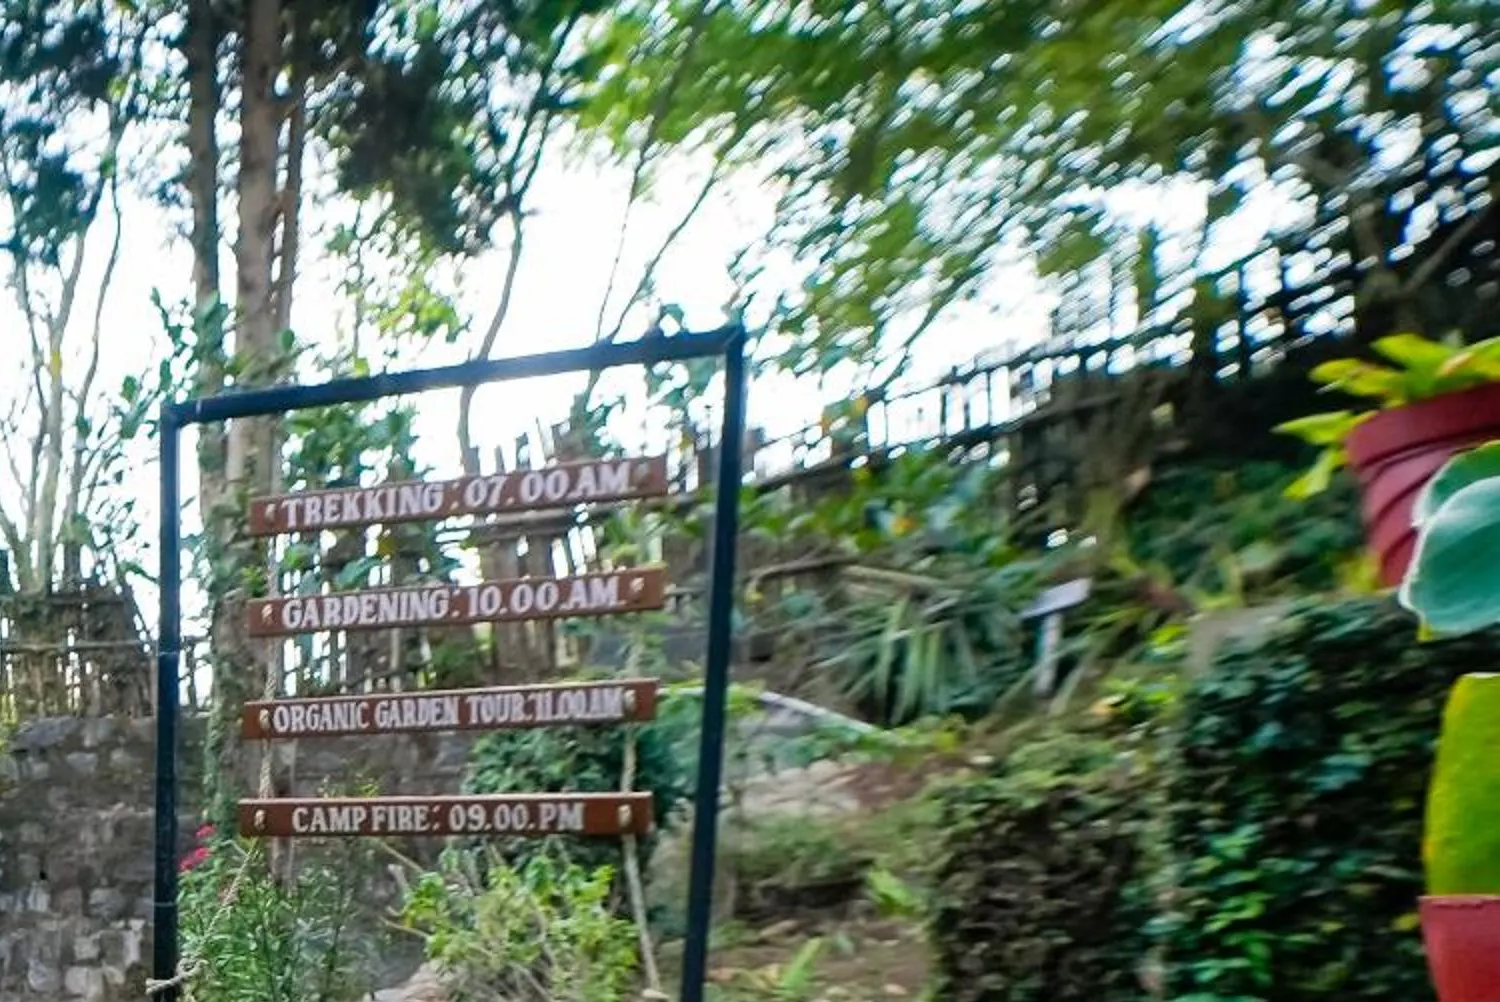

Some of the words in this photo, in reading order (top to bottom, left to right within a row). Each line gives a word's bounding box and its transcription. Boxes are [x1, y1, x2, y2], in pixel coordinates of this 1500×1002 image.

[273, 701, 370, 733] ORGANIC
[374, 695, 460, 728] GARDEN
[292, 806, 367, 832] CAMP
